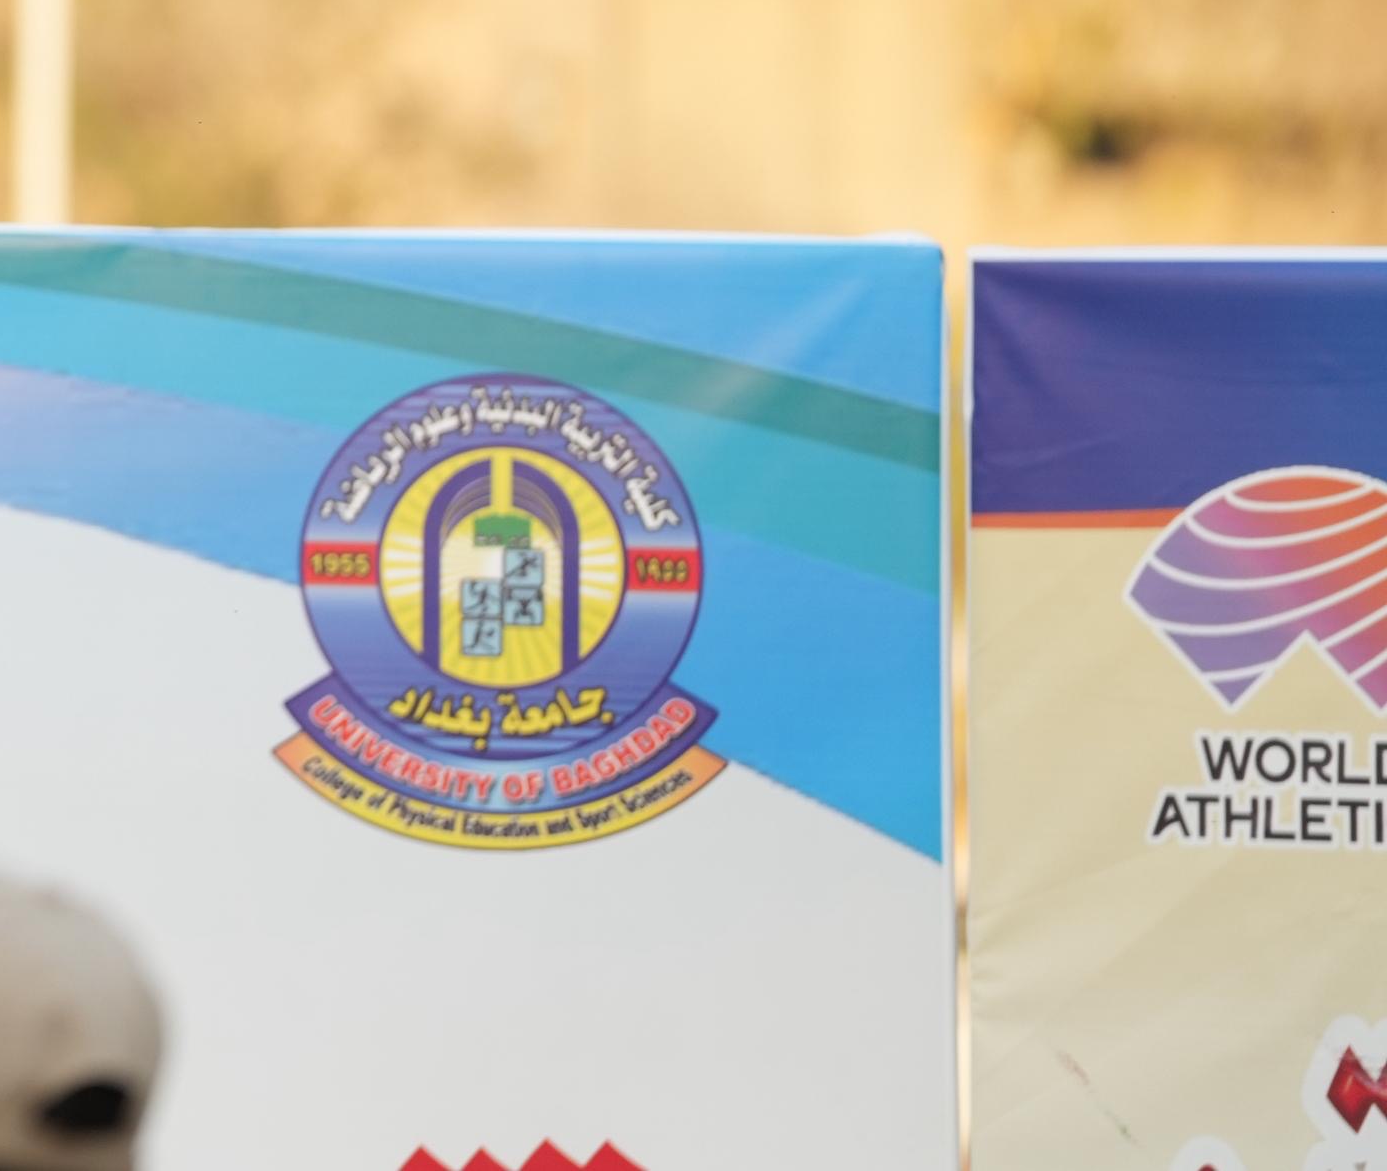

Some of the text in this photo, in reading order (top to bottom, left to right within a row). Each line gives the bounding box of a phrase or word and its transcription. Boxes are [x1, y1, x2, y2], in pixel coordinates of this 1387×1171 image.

[470, 386, 563, 437] البدنية
[560, 402, 640, 479] التربية
[320, 423, 413, 524] الرياضة
[623, 464, 680, 530] كلية
[311, 552, 371, 580] 1955
[310, 695, 697, 804] UNIVERSITY OF BAGHDAD
[388, 686, 615, 751] جامعة بغداد
